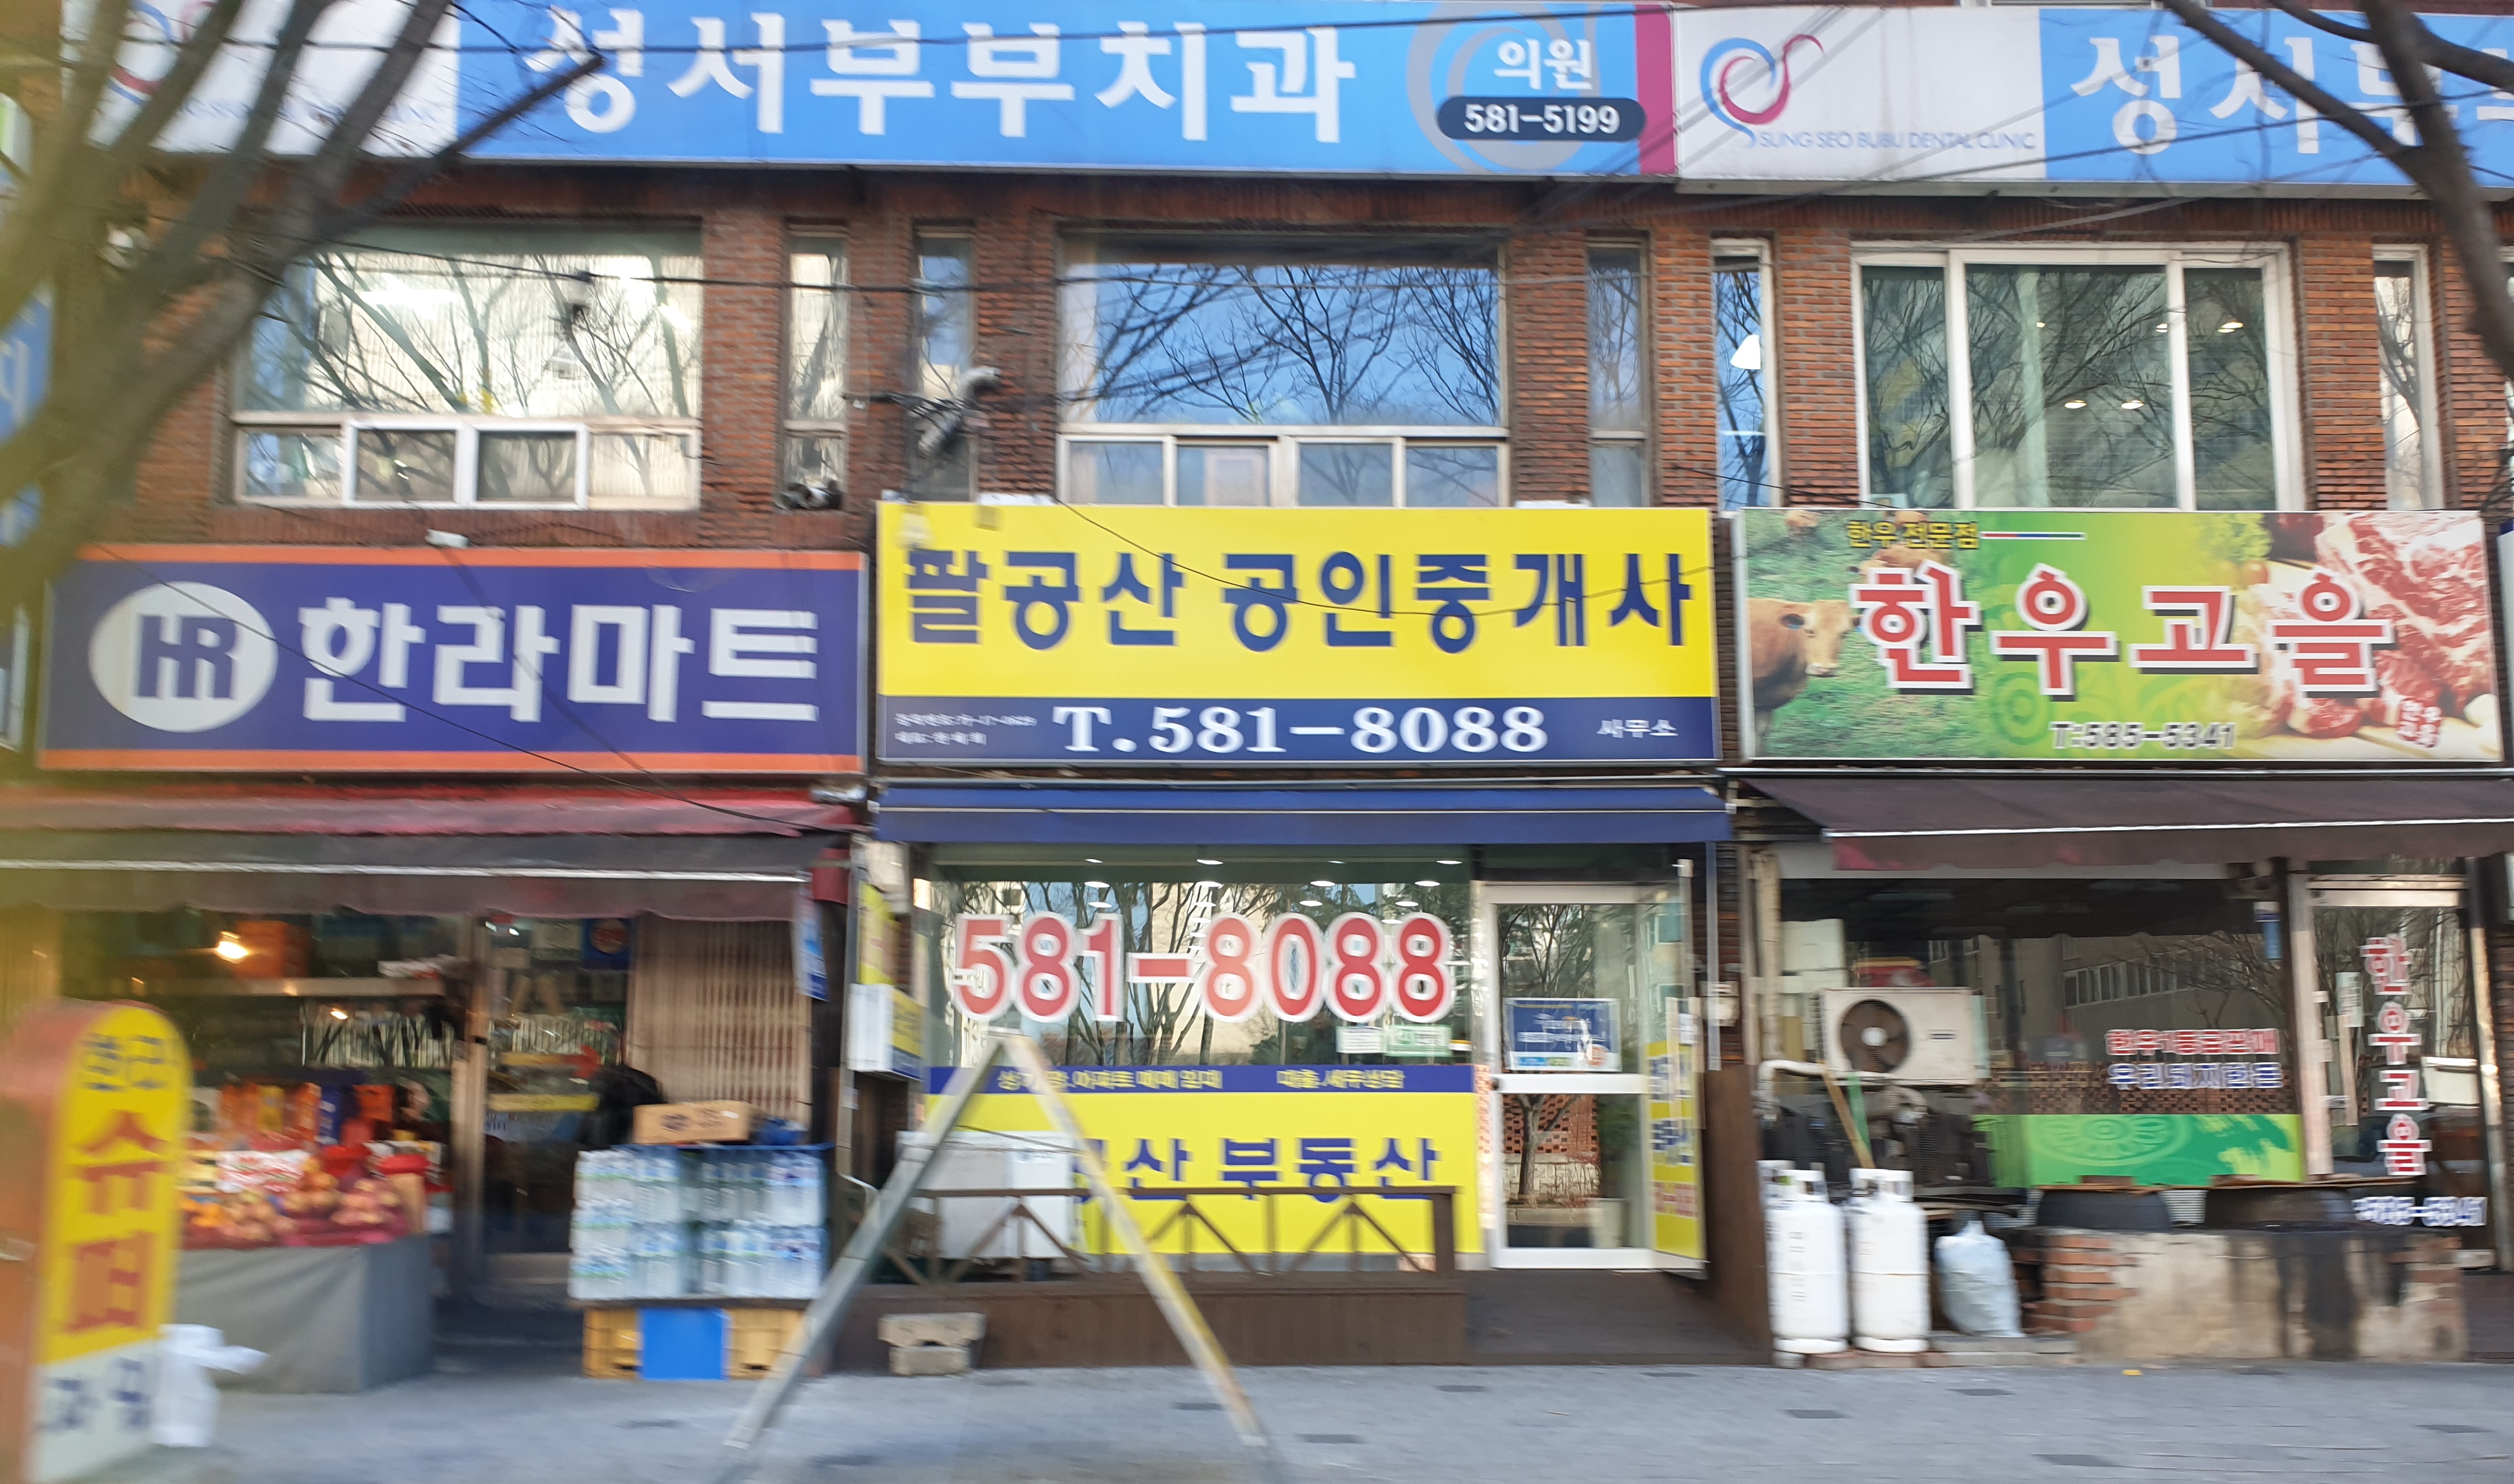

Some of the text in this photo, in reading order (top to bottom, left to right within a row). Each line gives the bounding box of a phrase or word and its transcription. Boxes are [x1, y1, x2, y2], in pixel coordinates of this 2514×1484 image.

[521, 4, 1357, 143] 성서부부치과
[1493, 37, 1594, 90] 의원
[1463, 103, 1621, 134] 581-5199
[1846, 520, 1980, 550] 한우 전문점
[904, 548, 1692, 653] 팔공산 공인중개사
[1847, 559, 2396, 700] 한우고을
[297, 596, 819, 723] 한라마트
[1596, 718, 1679, 739] 사무소
[953, 910, 1455, 1023] 581-8088
[1218, 1136, 1442, 1203] 부동산
